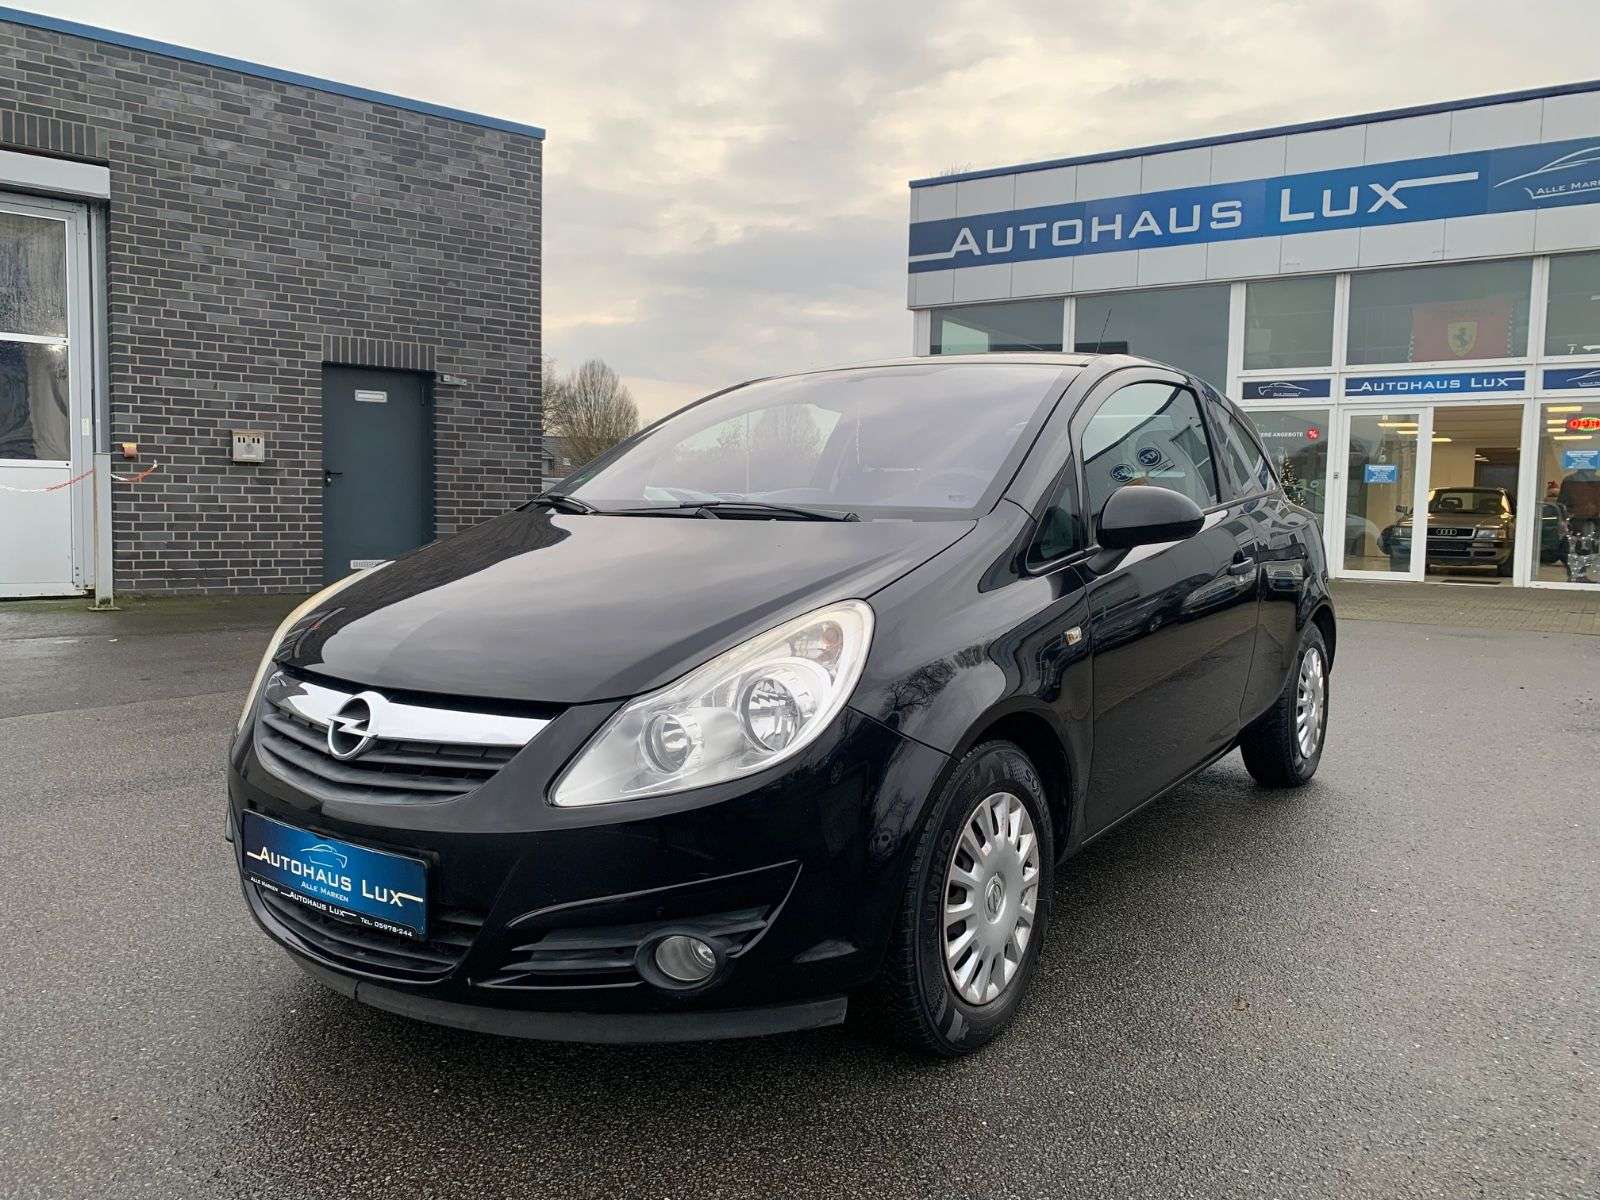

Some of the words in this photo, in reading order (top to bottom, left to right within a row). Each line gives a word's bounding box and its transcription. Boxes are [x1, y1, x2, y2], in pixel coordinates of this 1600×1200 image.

[1537, 185, 1566, 195] ALLE
[1571, 180, 1600, 190] MAR
[950, 199, 1242, 257] AUTOHAUS
[1280, 179, 1409, 223] LUX
[1360, 379, 1461, 392] AUTOHAUS
[1470, 377, 1509, 388] LUX
[260, 846, 352, 892] AUTOHAUS
[361, 879, 403, 907] LUX
[301, 881, 318, 892] ALLE
[320, 887, 349, 903] MARKEN
[250, 876, 261, 885] ALLE
[289, 891, 327, 911] AUTOHAUS
[329, 906, 345, 917] LUX
